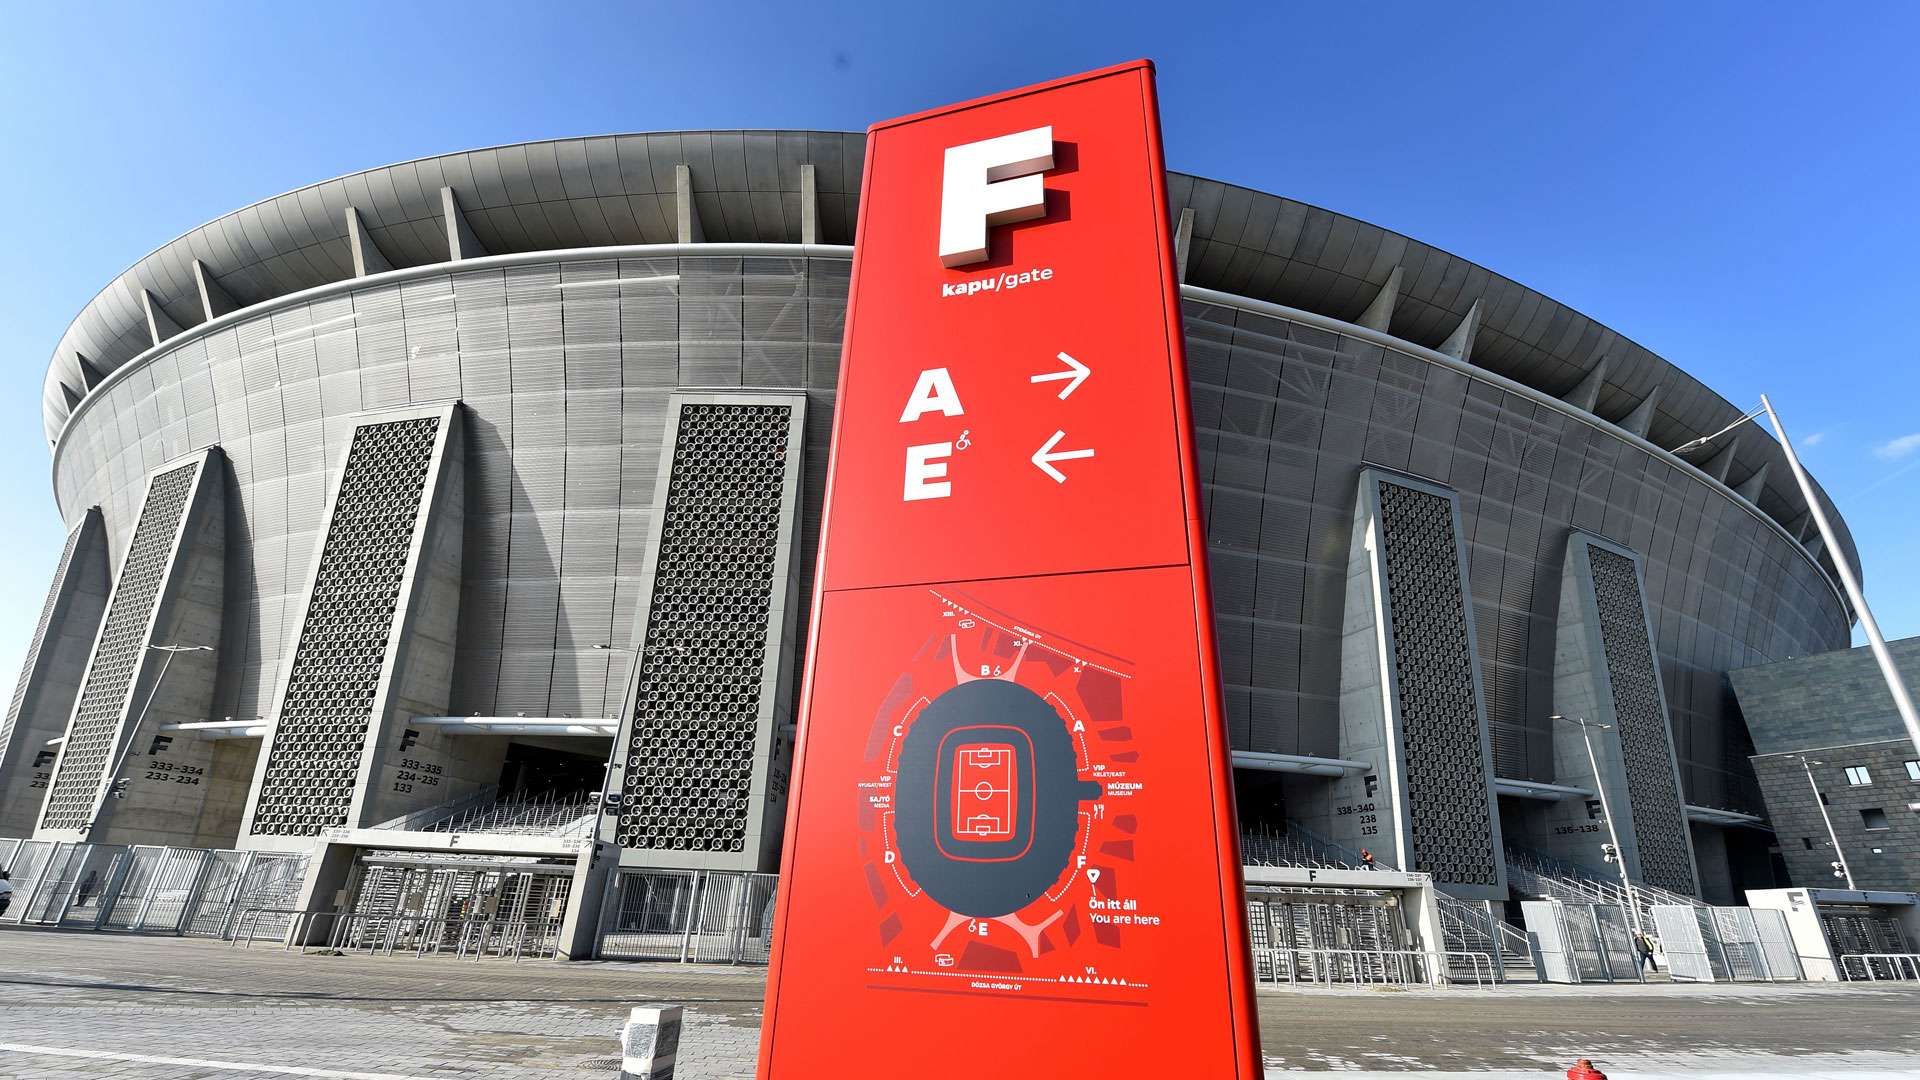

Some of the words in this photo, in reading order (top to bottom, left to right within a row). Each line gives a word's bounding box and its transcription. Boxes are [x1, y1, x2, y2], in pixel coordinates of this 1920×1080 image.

[939, 125, 1055, 268] F
[942, 268, 1053, 297] kapu/gate
[898, 368, 965, 423] A
[903, 441, 953, 502] E
[980, 665, 990, 676] B
[893, 725, 903, 737] C
[1073, 720, 1085, 732] A
[148, 735, 173, 755] F
[399, 728, 420, 752] F
[32, 750, 57, 767] F
[149, 760, 204, 775] 333-334
[400, 758, 443, 775] 333-335
[144, 771, 200, 785] 233-234
[397, 770, 440, 786] 234-235
[393, 782, 413, 793] 133
[1107, 781, 1143, 790] MÚZEUM
[1364, 774, 1378, 798] F
[1336, 803, 1375, 816] 338-340
[1584, 799, 1601, 819] F
[1360, 814, 1377, 824] 238
[1361, 826, 1378, 835] 135
[449, 835, 461, 848] F
[884, 850, 895, 864] D
[1077, 856, 1087, 868] F
[1309, 869, 1317, 882] F
[1088, 896, 1105, 909] Ön
[1107, 898, 1121, 910] itt
[1123, 898, 1137, 910] áll
[1089, 912, 1111, 924] You
[1113, 915, 1131, 925] are
[1134, 913, 1161, 926] here
[978, 922, 989, 936] E
[1085, 966, 1097, 975] VI.
